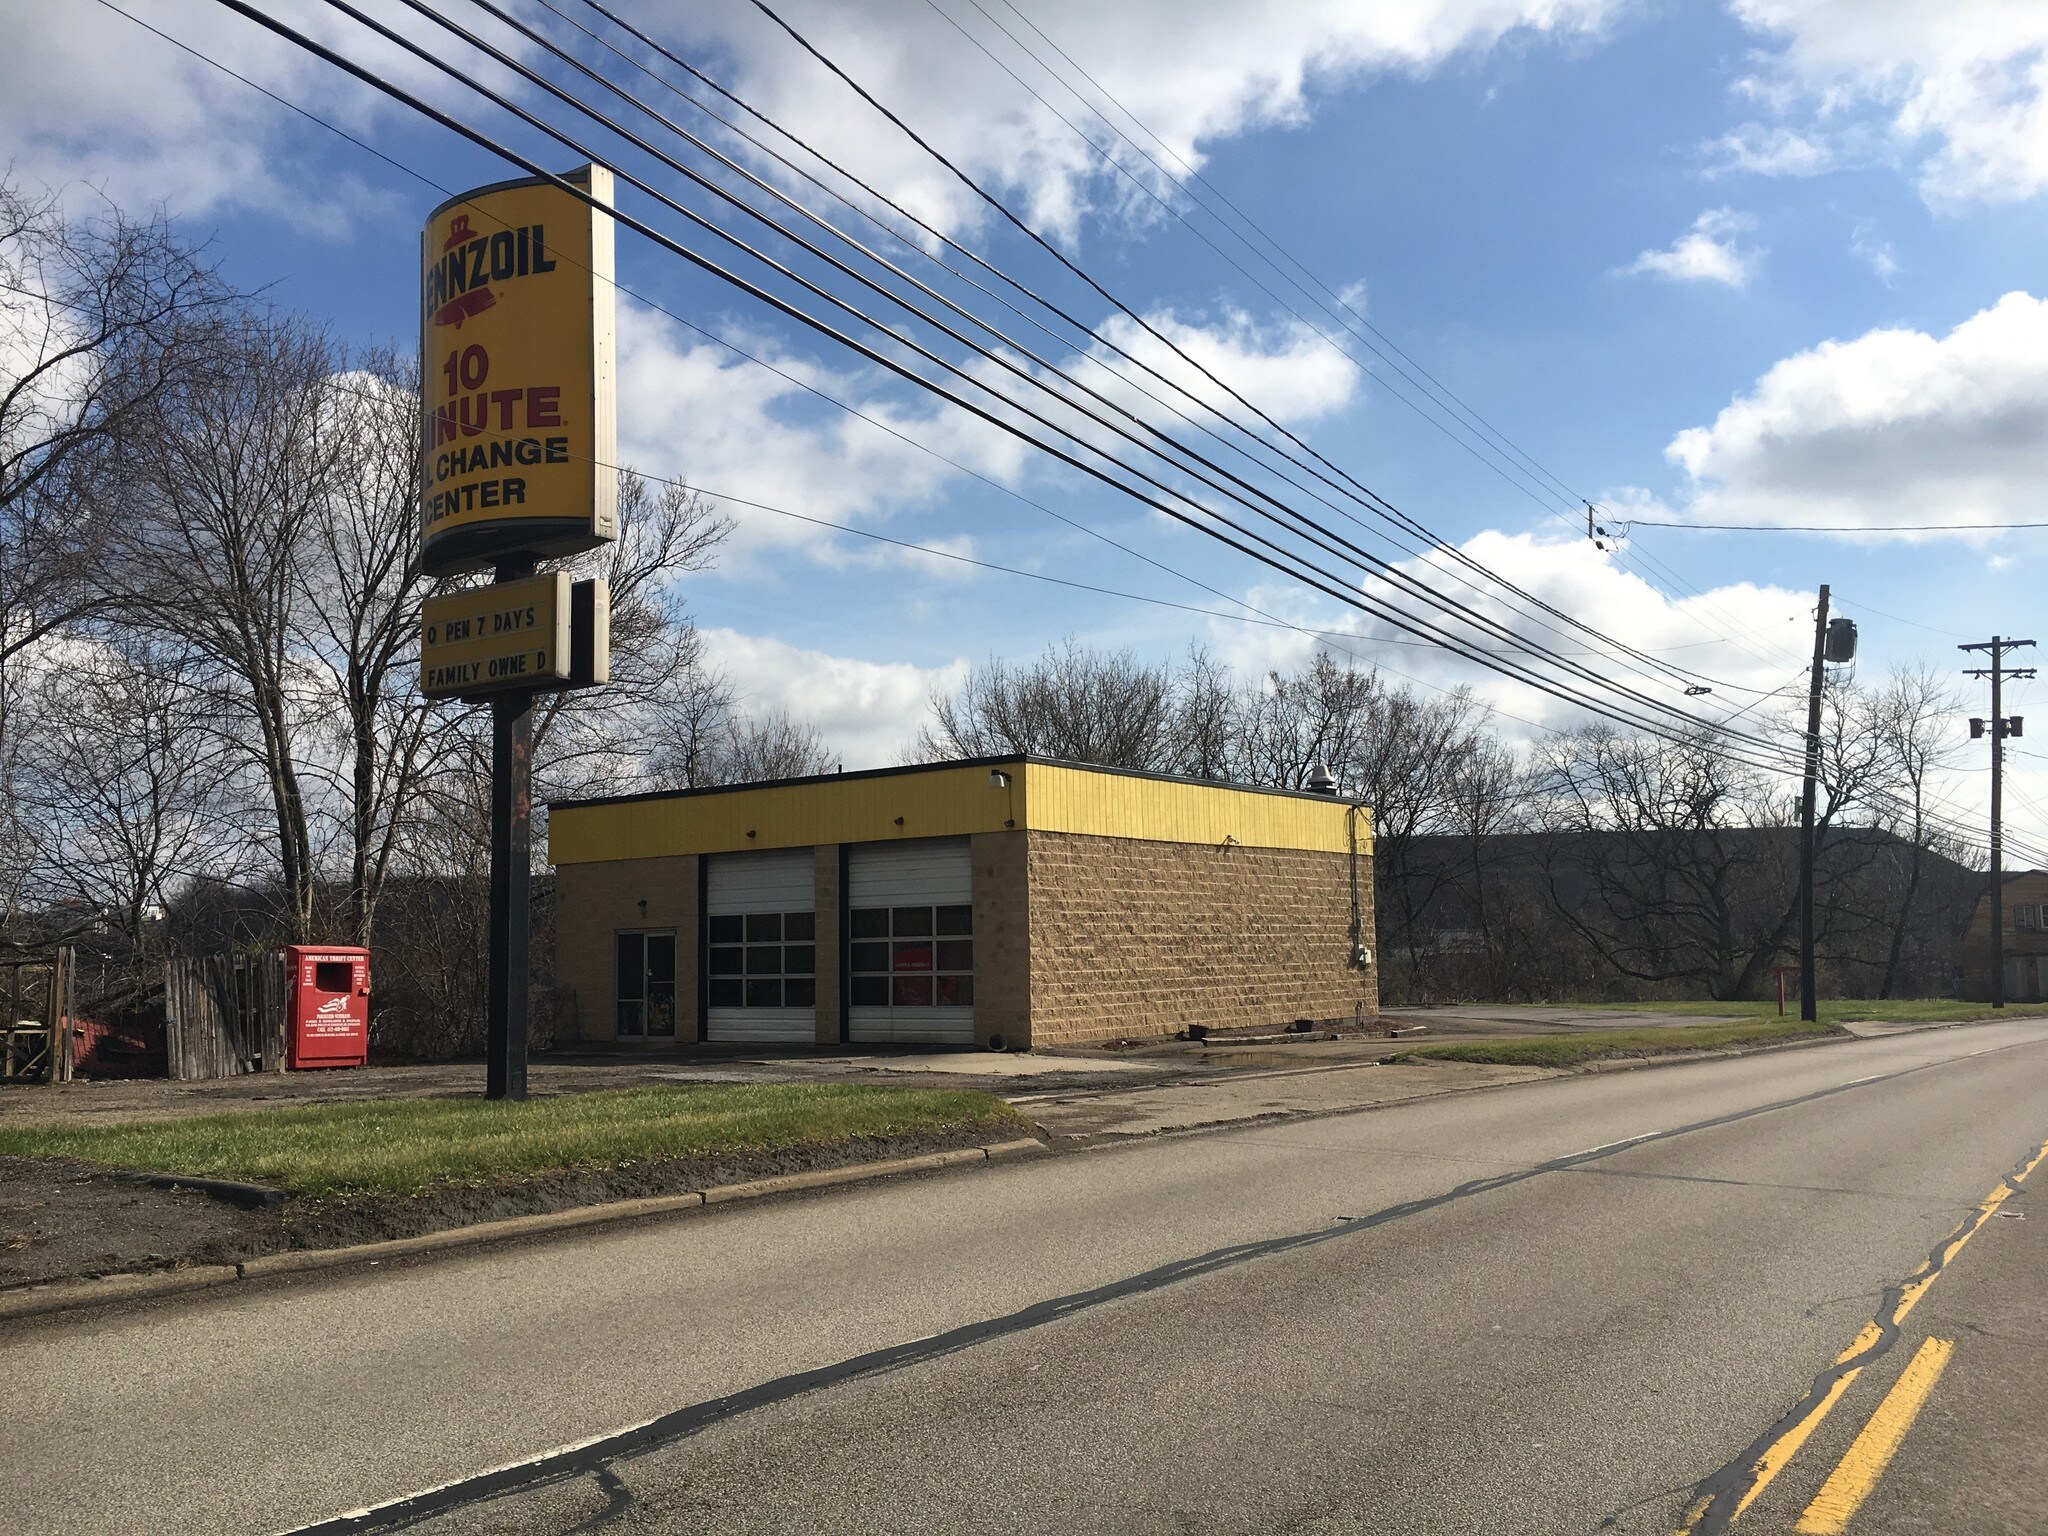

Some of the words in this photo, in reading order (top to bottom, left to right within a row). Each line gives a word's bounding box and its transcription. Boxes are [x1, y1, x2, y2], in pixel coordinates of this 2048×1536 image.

[426, 224, 556, 320] ENNZOIL
[443, 343, 489, 397] 10
[436, 437, 569, 482] CHANGE
[425, 477, 525, 527] CENTER
[477, 617, 485, 635] 7
[494, 607, 535, 632] DAYS
[428, 662, 481, 687] FAMILY
